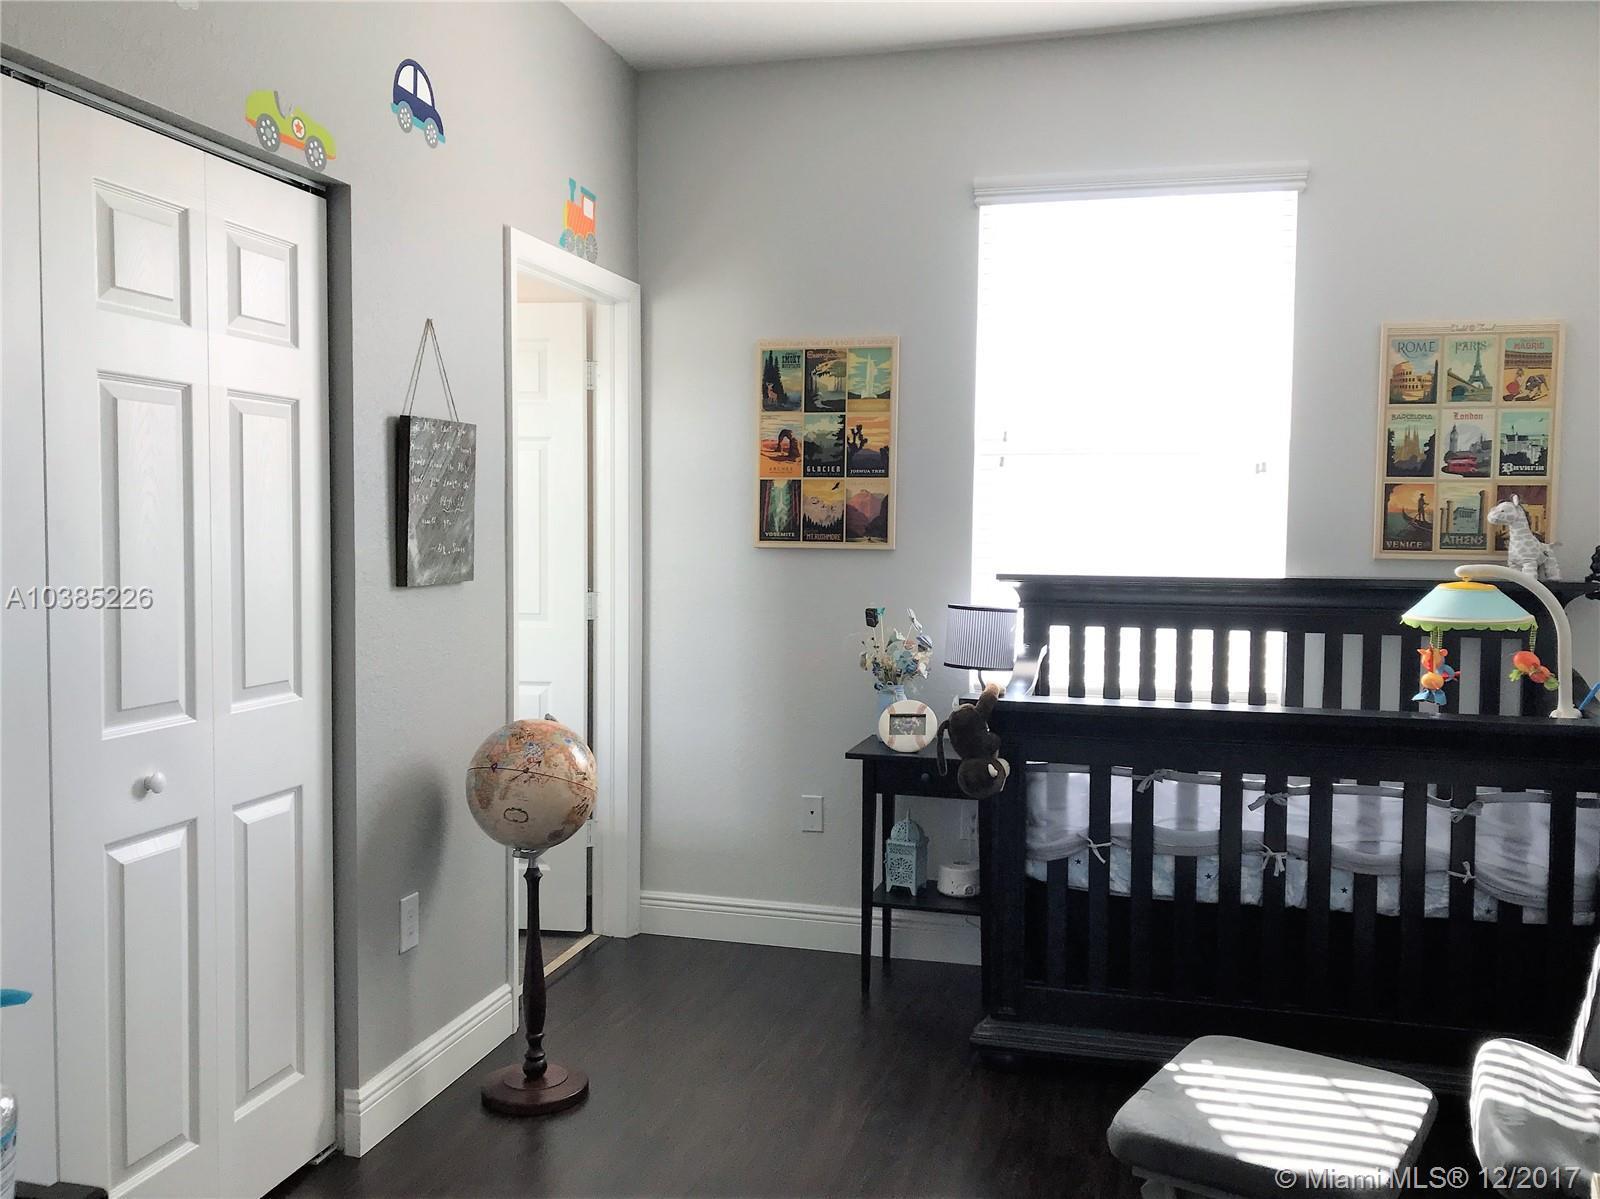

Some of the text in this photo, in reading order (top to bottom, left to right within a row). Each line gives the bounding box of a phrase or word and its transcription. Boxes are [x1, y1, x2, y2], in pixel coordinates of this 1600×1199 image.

[1397, 341, 1436, 356] ROME
[1455, 340, 1488, 354] PARIS
[1513, 342, 1545, 350] MADRID
[1453, 411, 1484, 420] London
[806, 465, 841, 473] GLACIER
[1501, 462, 1545, 475] Bavaria
[1442, 535, 1484, 545] ATHENS
[1386, 541, 1423, 549] VENICE
